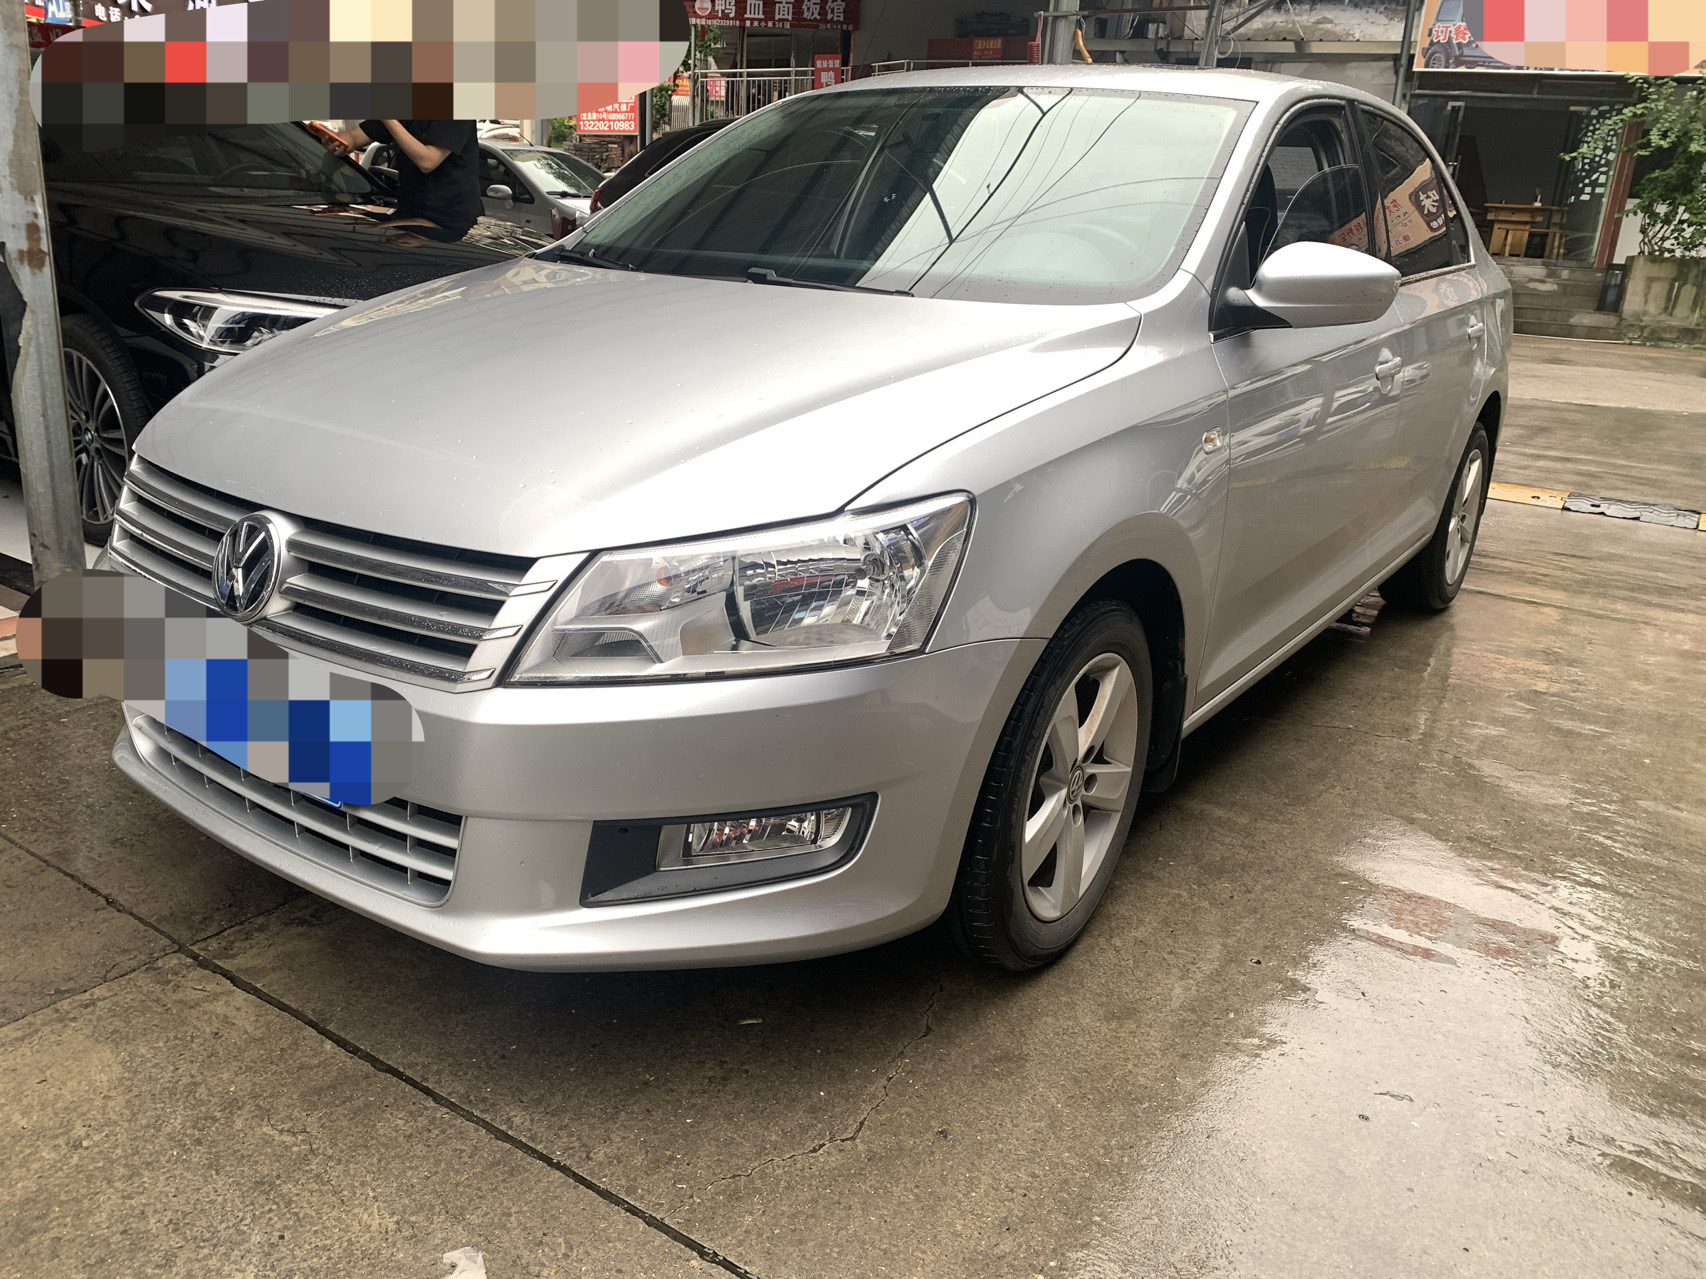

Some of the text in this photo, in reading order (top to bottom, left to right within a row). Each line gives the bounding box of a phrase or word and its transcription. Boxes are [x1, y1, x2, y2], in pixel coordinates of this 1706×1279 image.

[94, 3, 121, 22] 电话
[714, 0, 846, 22] 鸭血面饭馆
[1433, 23, 1470, 43] 订餐
[820, 71, 835, 88] 鸭
[579, 120, 635, 131] 13220210983
